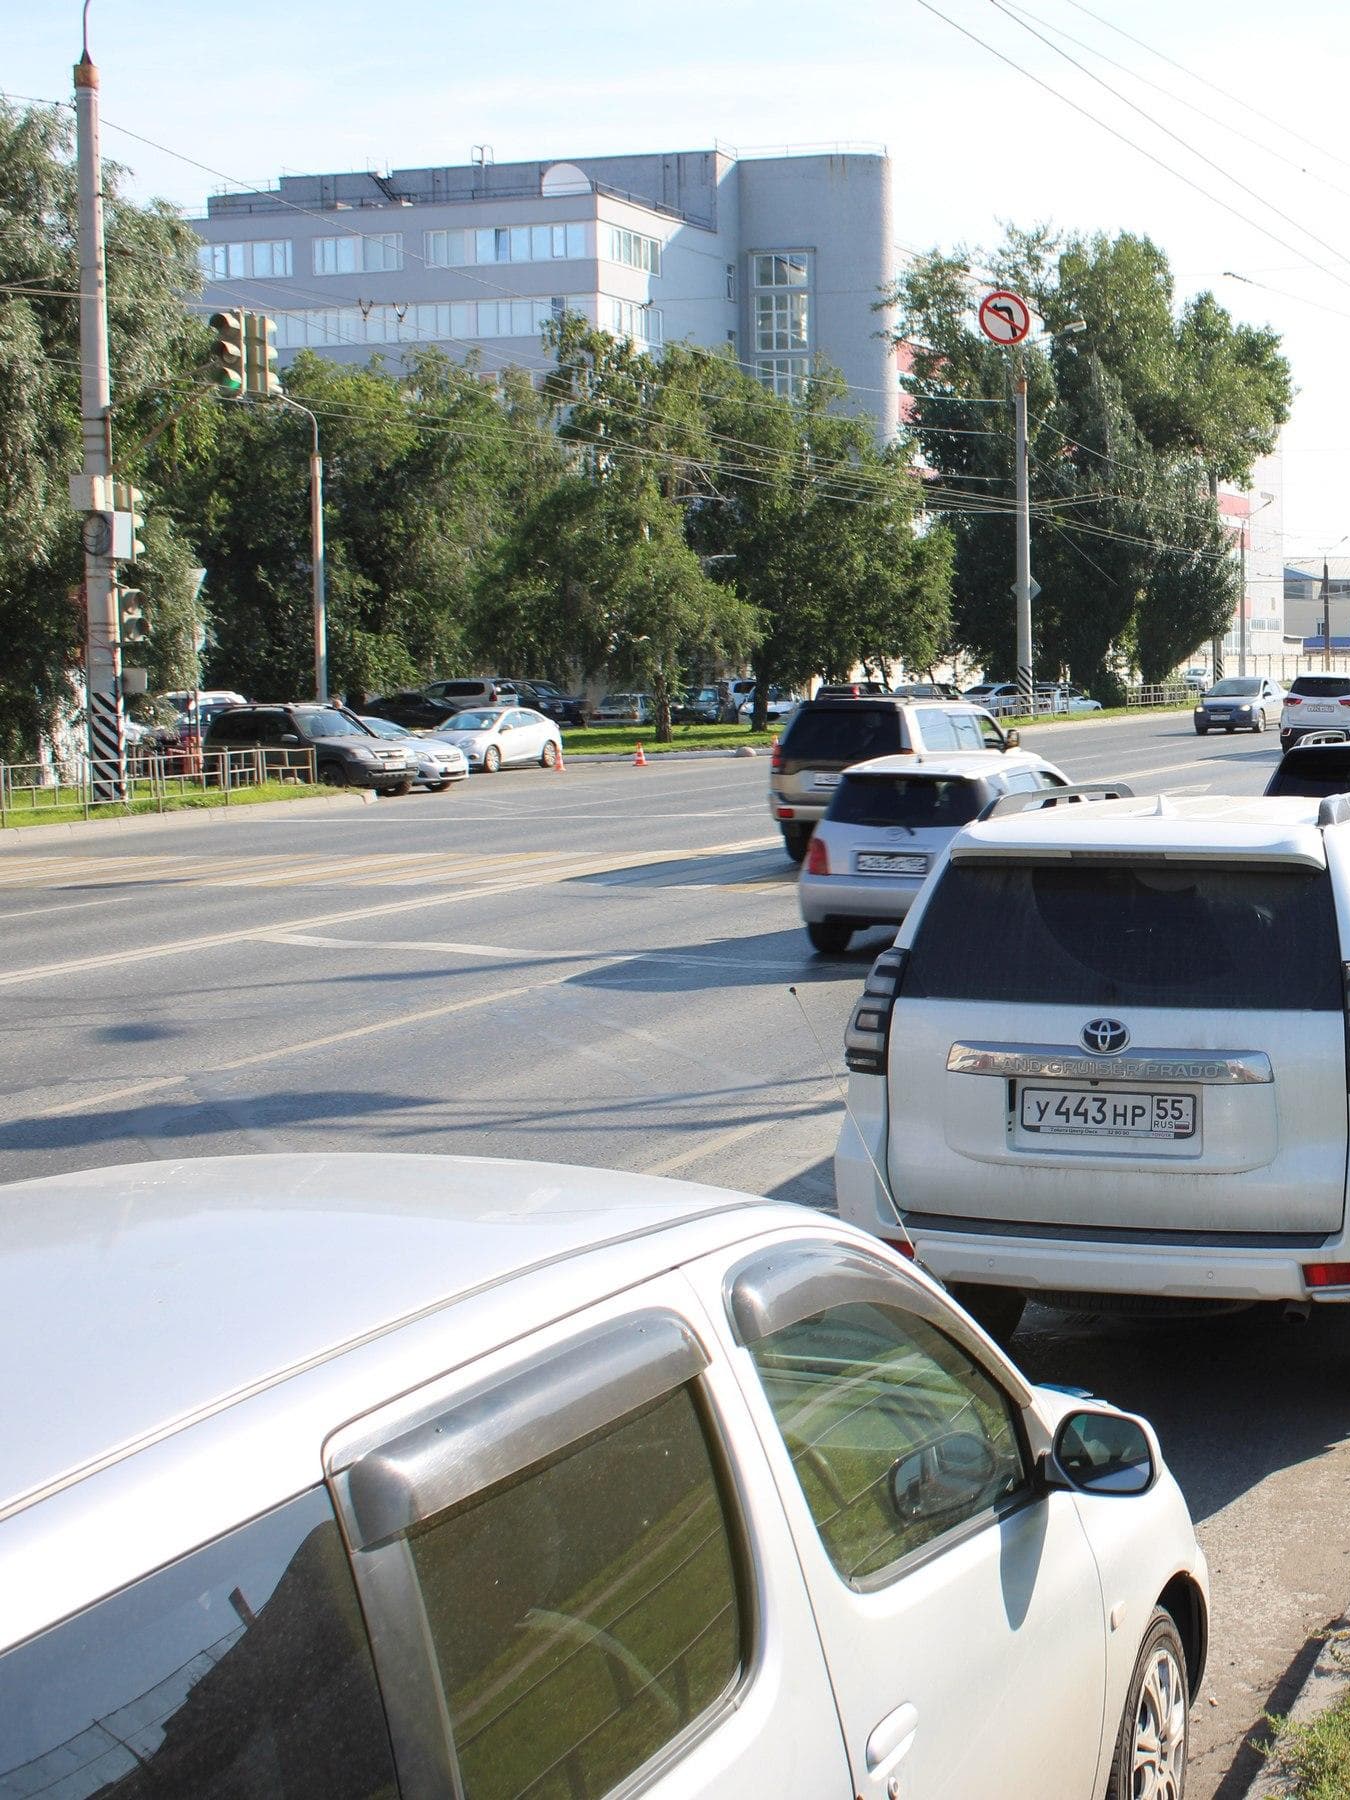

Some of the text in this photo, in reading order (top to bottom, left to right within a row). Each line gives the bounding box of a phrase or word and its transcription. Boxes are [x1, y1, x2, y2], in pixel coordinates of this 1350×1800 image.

[989, 1055, 1221, 1079] LAND CRUISER PRADO
[1153, 1120, 1174, 1129] RUS
